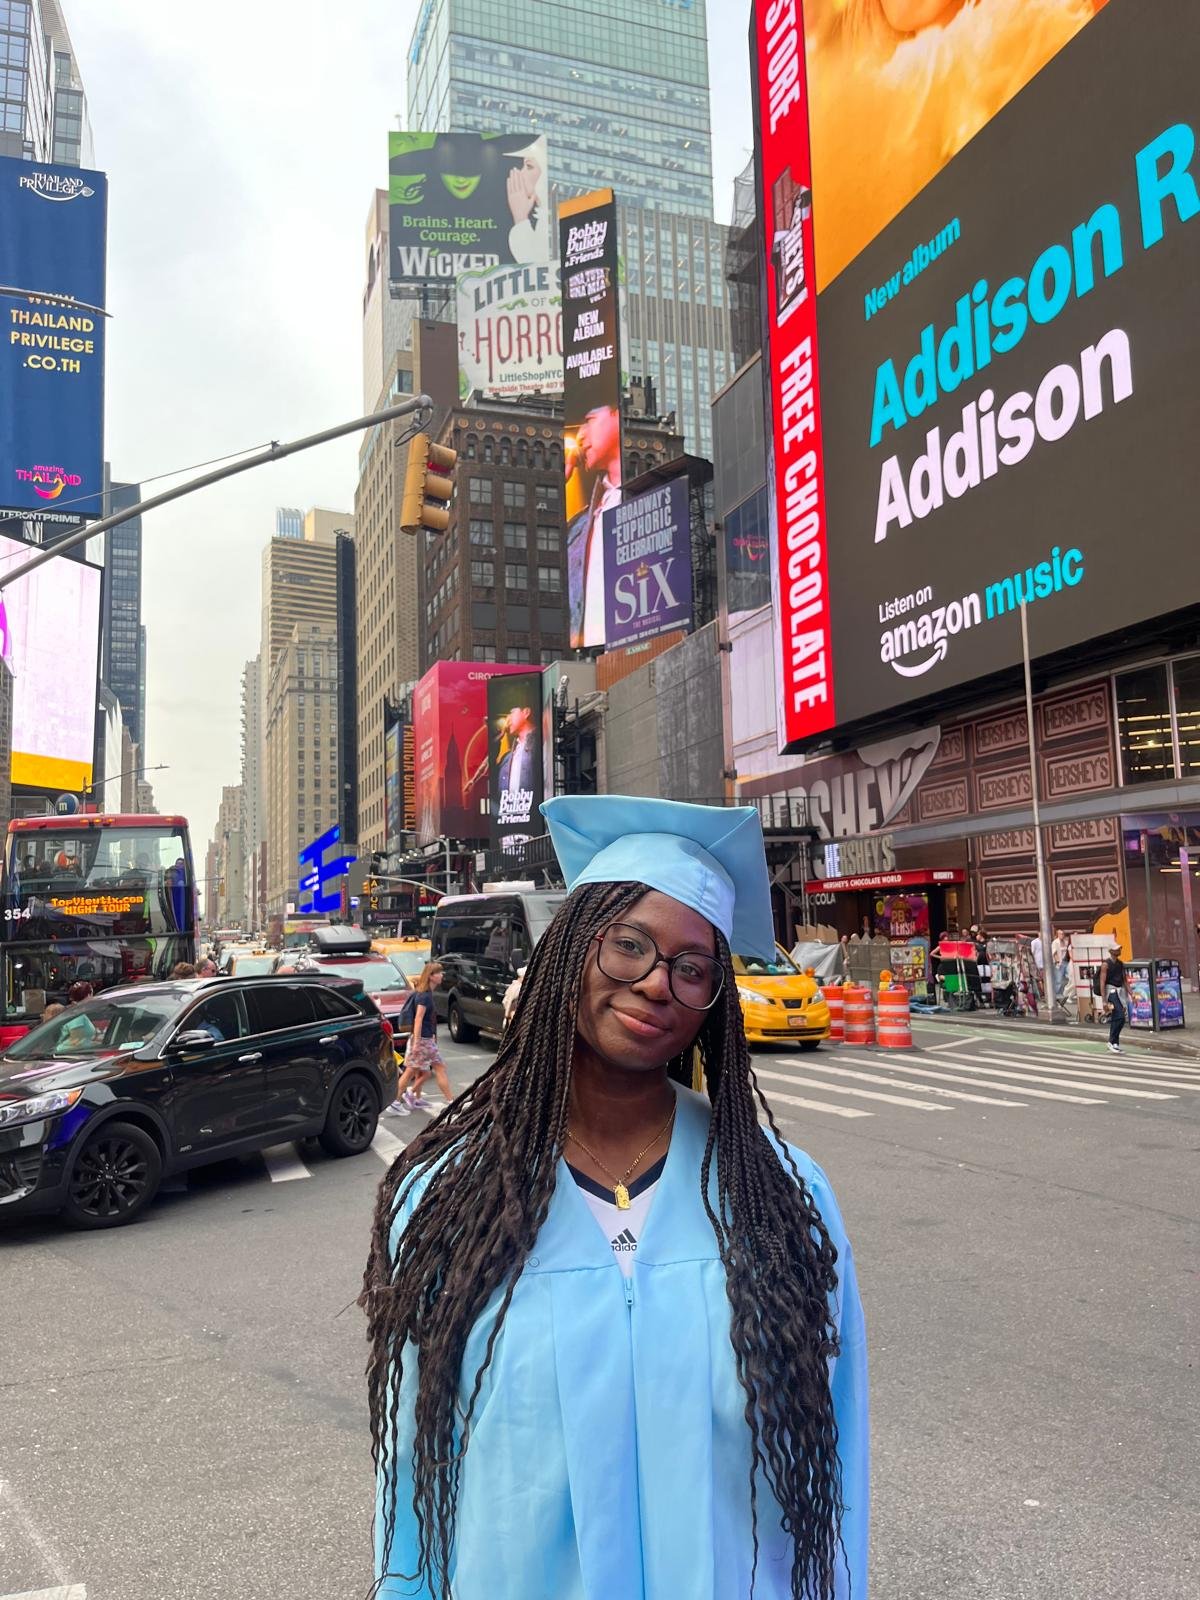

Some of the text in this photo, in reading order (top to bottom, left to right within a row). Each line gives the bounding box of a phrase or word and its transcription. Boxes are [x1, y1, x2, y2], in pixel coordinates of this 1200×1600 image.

[20, 176, 78, 195] PRIVILEGE
[32, 172, 84, 187] THAILAND
[402, 215, 498, 229] Brains. Heart.
[569, 221, 608, 243] Bobby
[420, 230, 480, 245] Courage.
[864, 217, 961, 321] New album
[475, 267, 550, 312] LITTLE
[10, 309, 94, 333] THAILAND
[578, 309, 599, 327] NEW
[869, 203, 1125, 448] Addison
[10, 331, 94, 354] PRIVILEGE
[573, 321, 604, 342] ALBUM
[22, 354, 81, 373] .CO.TH
[566, 345, 614, 370] AVAILABLE
[579, 361, 601, 379] NOW
[780, 336, 815, 454] FREE
[874, 328, 1133, 545] Addison
[16, 469, 82, 487] THAILAND
[33, 464, 65, 475] amazing
[615, 486, 672, 526] BROADWAY'S
[784, 450, 828, 713] CHOCOLATE
[878, 585, 933, 623] Listen on
[880, 545, 1085, 663] amazon music
[1047, 695, 1105, 728] HERSHEY'S
[1050, 757, 1110, 789] HERSHEY'S
[921, 788, 965, 814] HERSHEY'S
[824, 835, 895, 878] HERSHEY'S
[823, 874, 902, 890] HERSHEY'S CHOCOLATE WORLD
[1057, 874, 1118, 901] HERSHEY'S
[4, 909, 31, 920] 354
[64, 903, 131, 915] NIGHT TOUR
